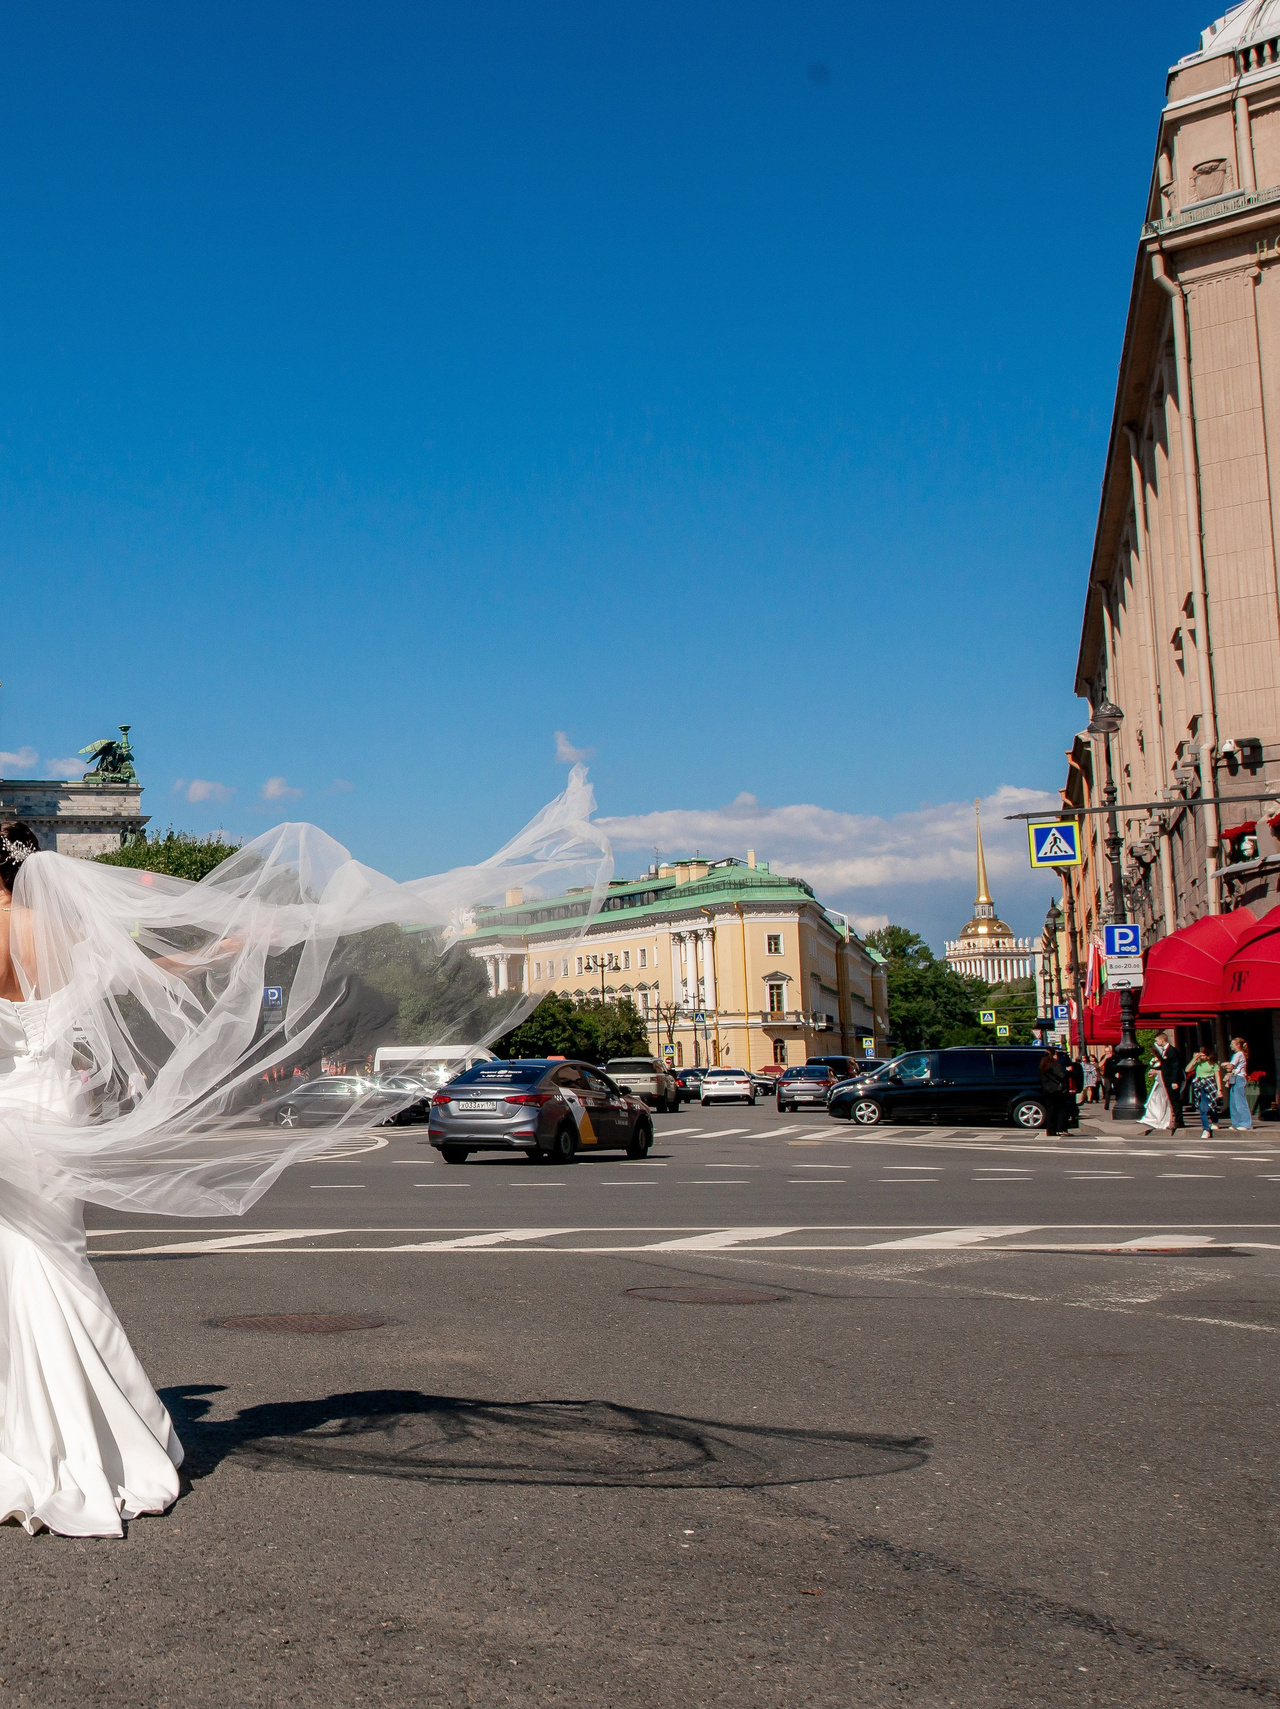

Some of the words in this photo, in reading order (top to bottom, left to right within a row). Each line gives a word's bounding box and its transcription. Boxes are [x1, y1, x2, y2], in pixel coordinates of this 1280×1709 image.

[1114, 928, 1134, 952] P
[268, 989, 279, 1006] P
[1058, 1006, 1067, 1018] P
